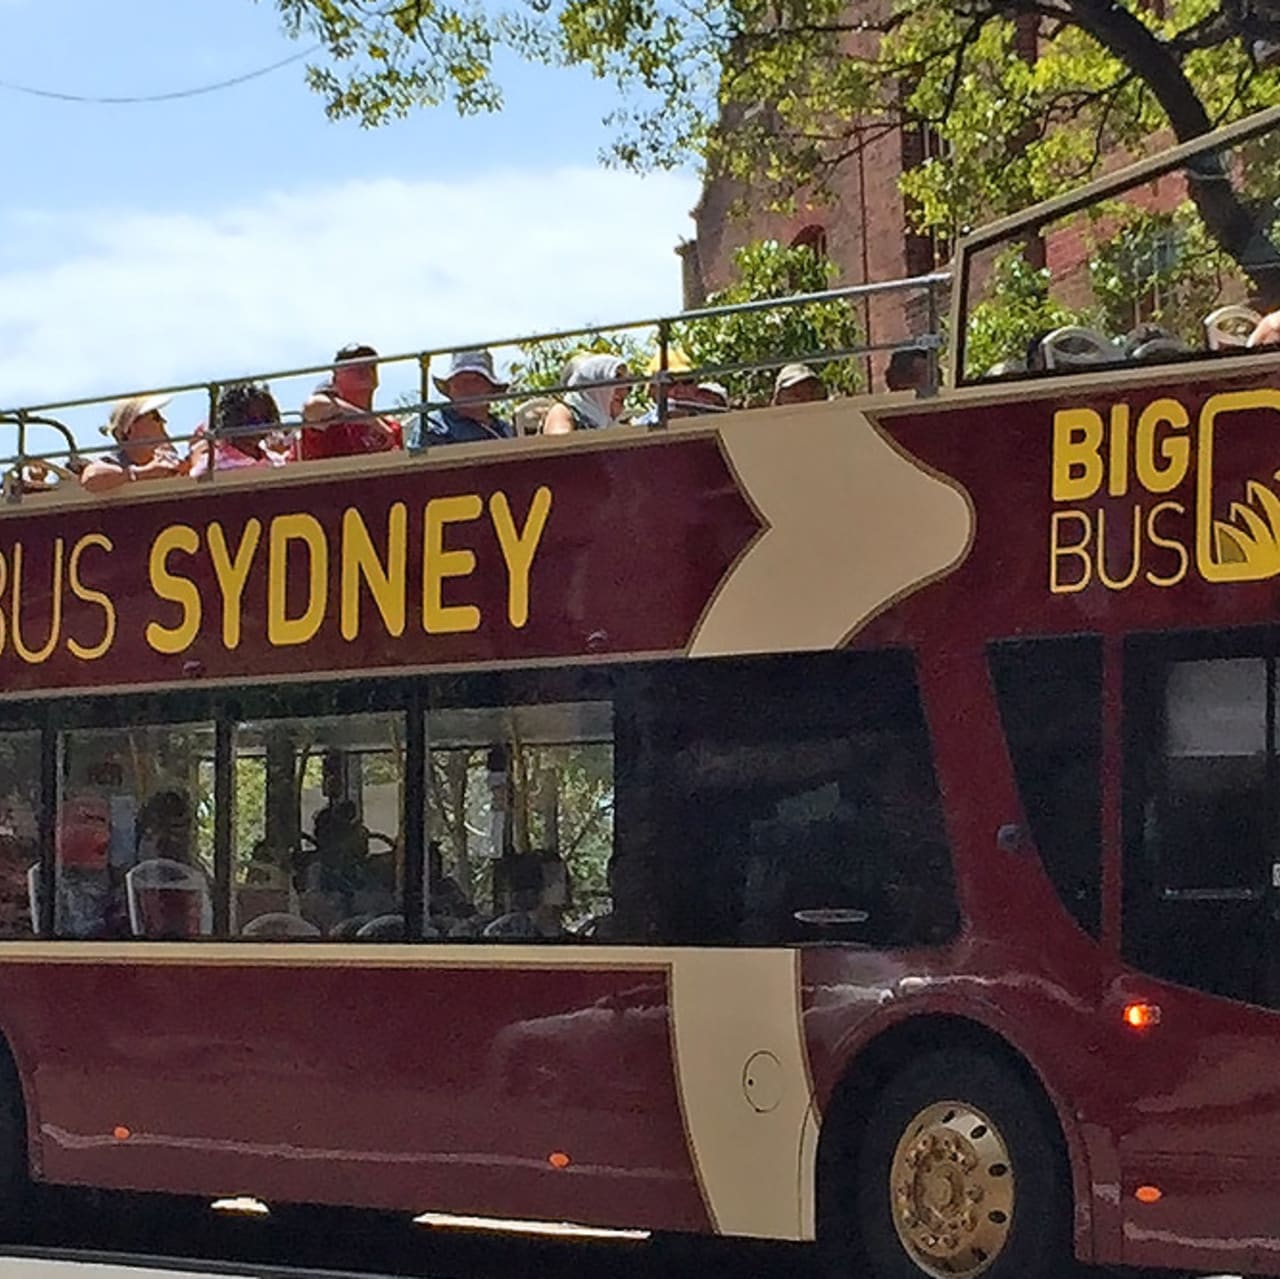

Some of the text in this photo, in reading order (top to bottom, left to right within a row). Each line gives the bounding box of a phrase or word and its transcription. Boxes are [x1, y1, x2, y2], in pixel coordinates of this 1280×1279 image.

[1051, 398, 1191, 502] BIG
[144, 486, 552, 655] SYDNEY
[1049, 501, 1190, 594] BUS
